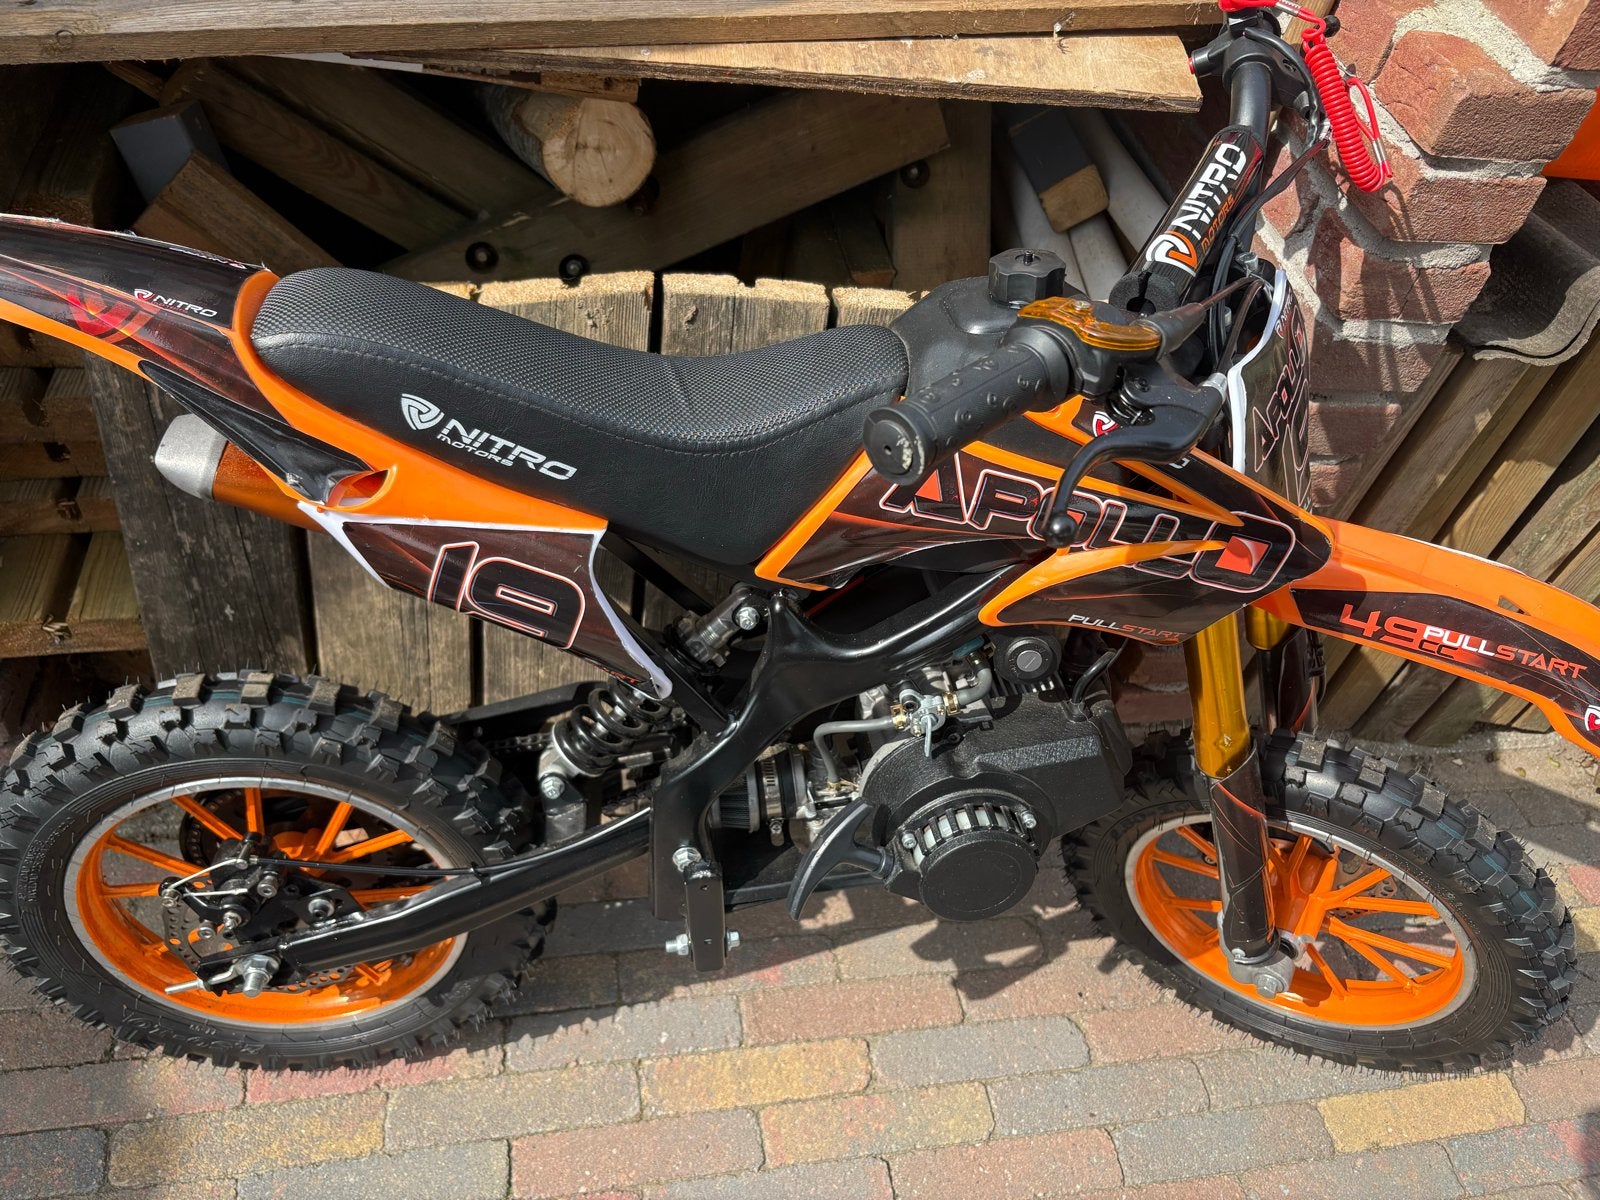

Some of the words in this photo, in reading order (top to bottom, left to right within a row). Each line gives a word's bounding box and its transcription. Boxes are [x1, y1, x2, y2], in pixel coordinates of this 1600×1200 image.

[1171, 143, 1247, 241] NITRO
[1201, 193, 1235, 255] MOTORS
[153, 295, 218, 318] NITRO
[436, 433, 514, 467] MOTORS
[441, 418, 578, 481] NITRO
[427, 541, 585, 650] 19
